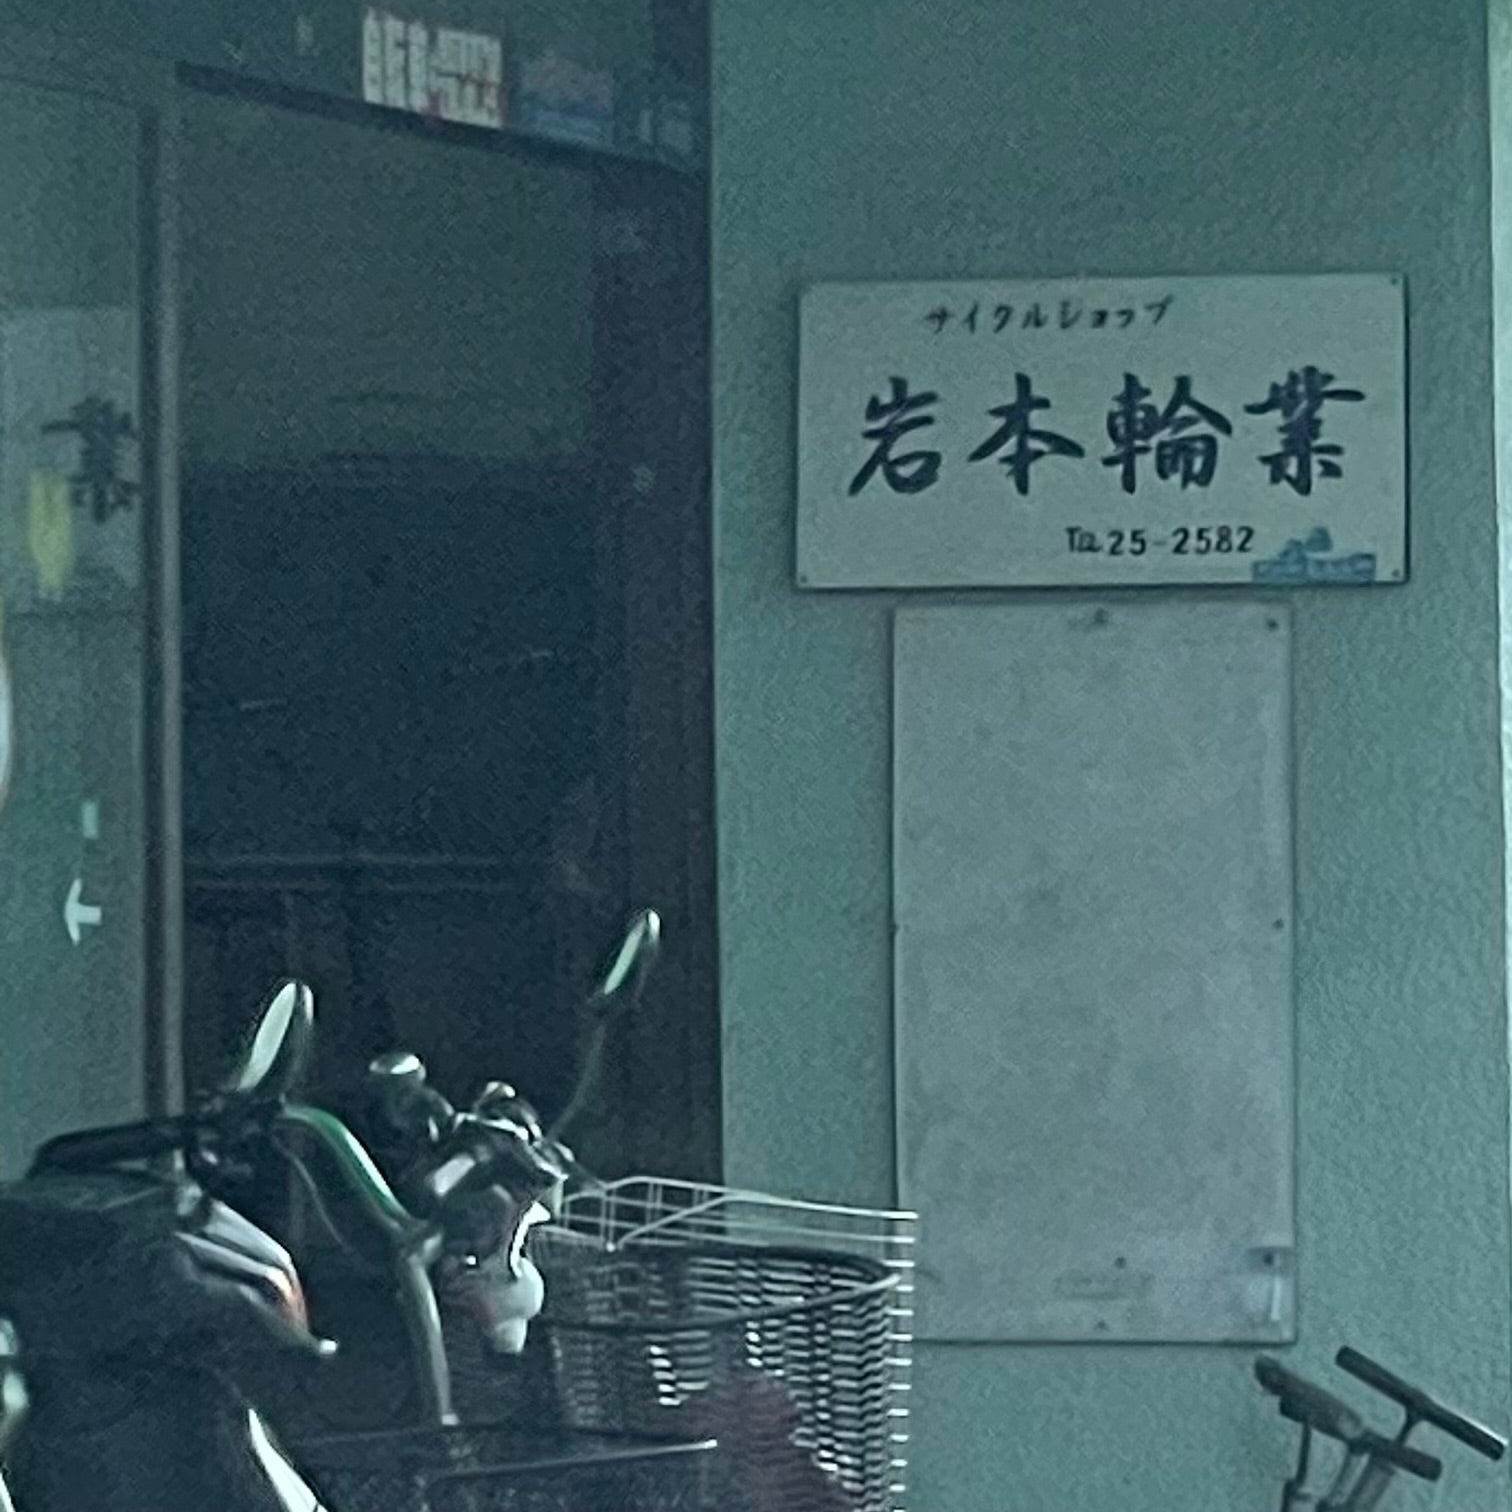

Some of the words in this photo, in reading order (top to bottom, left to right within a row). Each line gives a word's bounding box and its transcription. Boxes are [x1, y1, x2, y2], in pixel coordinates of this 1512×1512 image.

[923, 294, 1174, 334] サイクルショップ
[848, 365, 1366, 497] 岩本輪業
